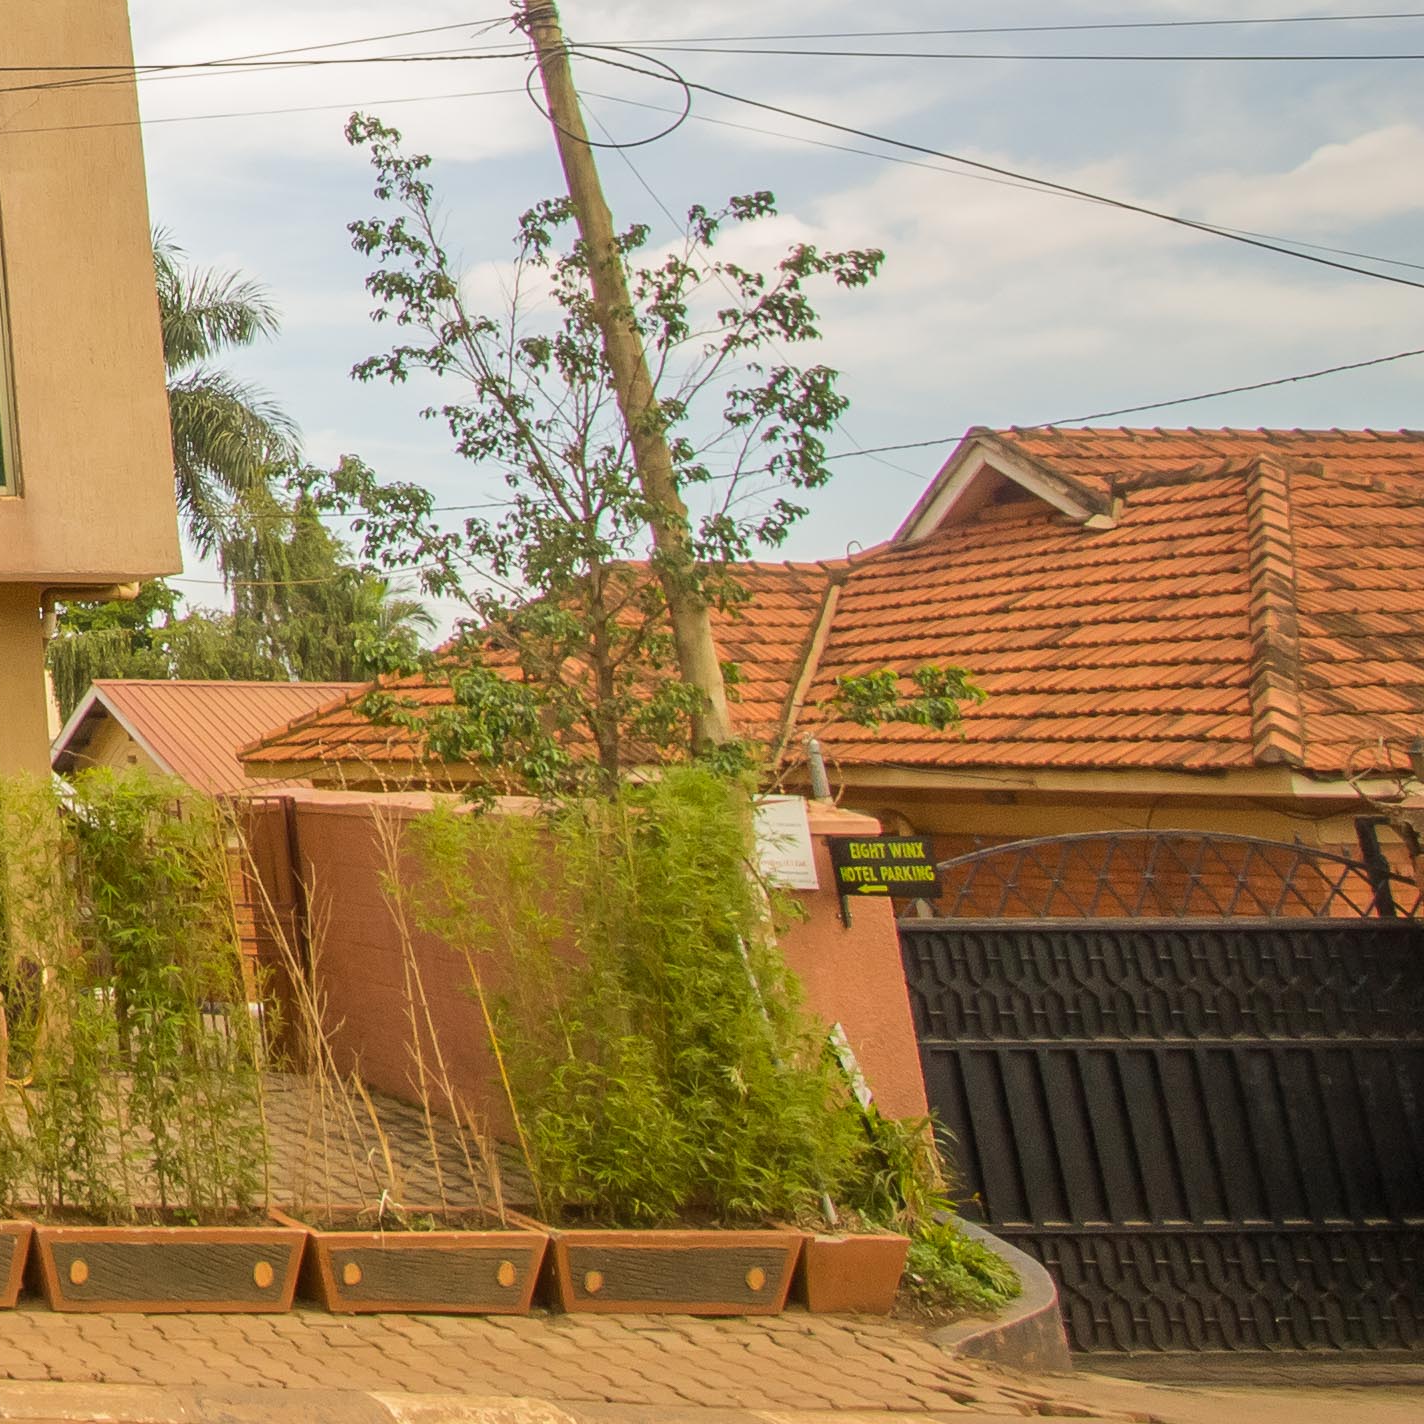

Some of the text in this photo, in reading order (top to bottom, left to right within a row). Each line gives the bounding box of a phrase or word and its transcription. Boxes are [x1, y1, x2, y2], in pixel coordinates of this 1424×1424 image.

[849, 842, 926, 859] EIGHT WINX
[839, 864, 935, 882] HOTEL PARKING
